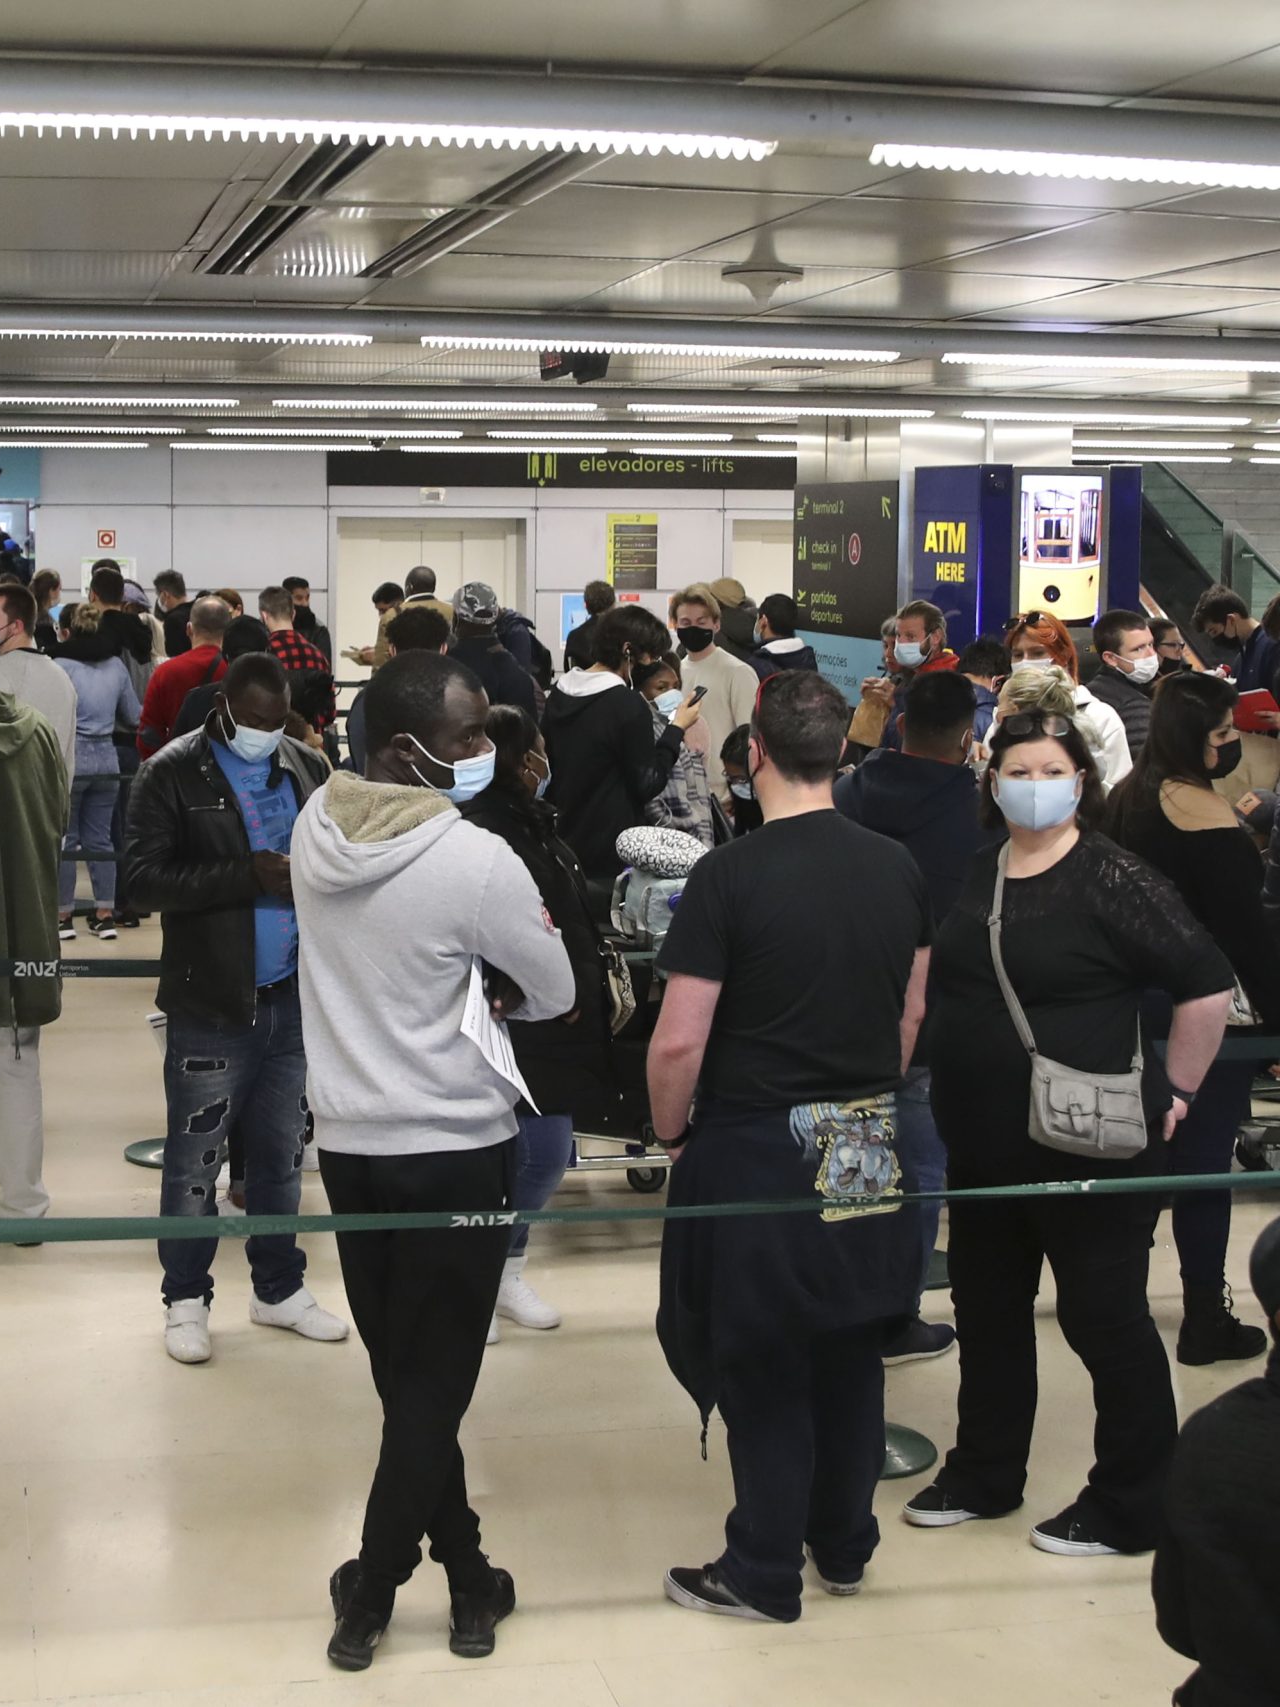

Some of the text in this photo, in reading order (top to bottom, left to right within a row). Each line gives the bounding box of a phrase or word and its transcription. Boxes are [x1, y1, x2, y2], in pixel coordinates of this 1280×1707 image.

[579, 456, 685, 473] elevadores
[702, 457, 735, 473] lifts
[812, 500, 839, 515] terminal
[924, 521, 966, 554] ATM
[811, 540, 837, 554] check in
[936, 561, 965, 583] HERE
[810, 590, 837, 606] partidas
[810, 606, 843, 624] departures
